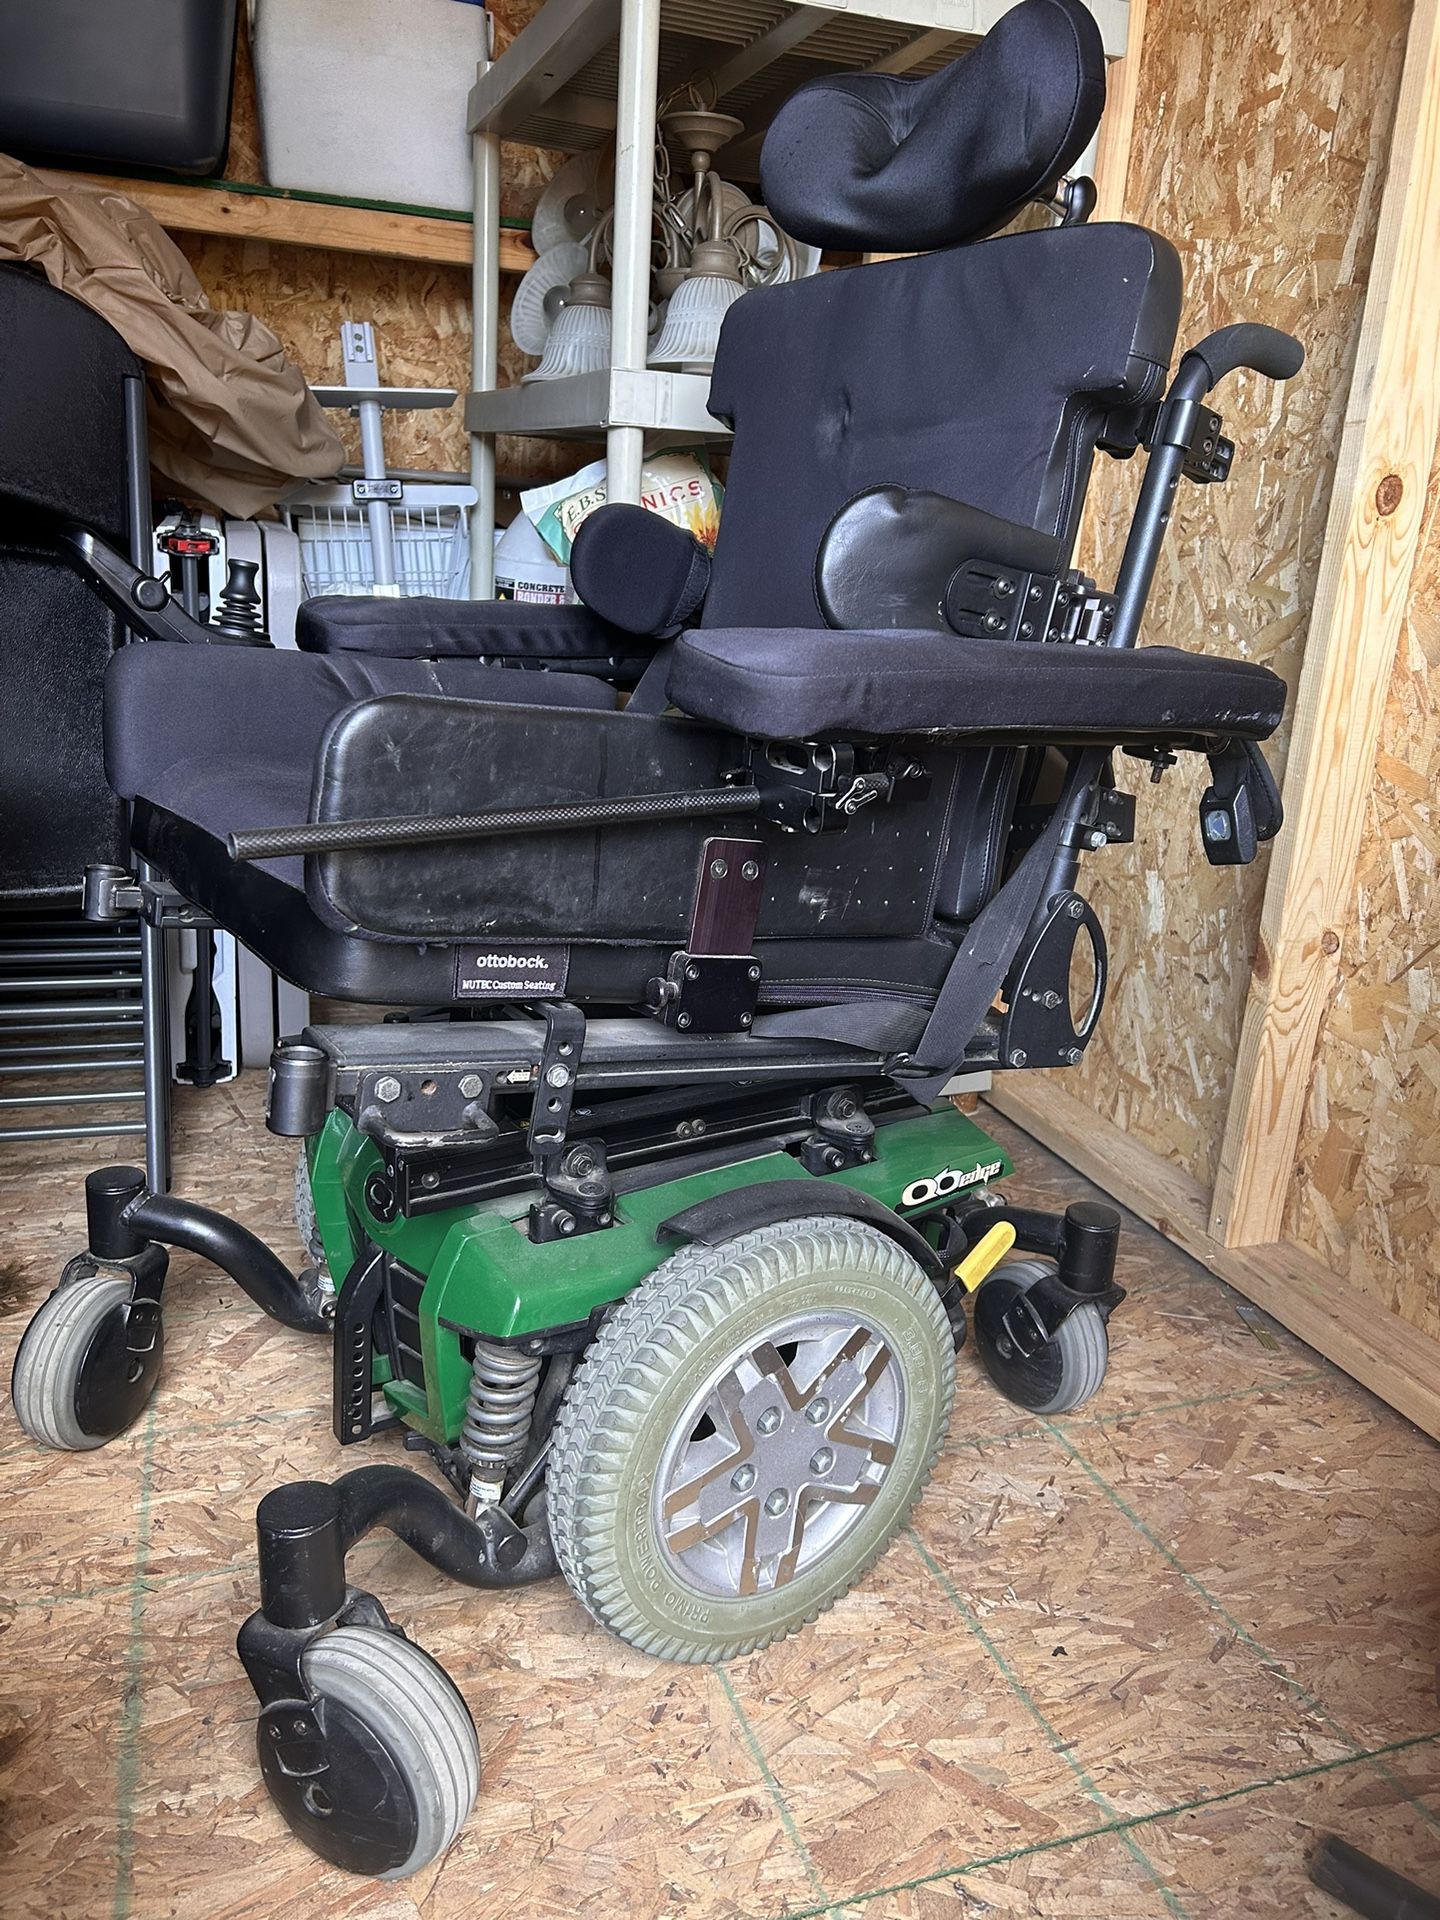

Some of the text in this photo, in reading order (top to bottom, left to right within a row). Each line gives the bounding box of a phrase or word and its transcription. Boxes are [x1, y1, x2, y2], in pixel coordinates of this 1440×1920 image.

[640, 480, 700, 511] NICS
[517, 581, 565, 593] CONCRETE
[492, 980, 523, 990] Custom
[524, 980, 557, 991] Seating
